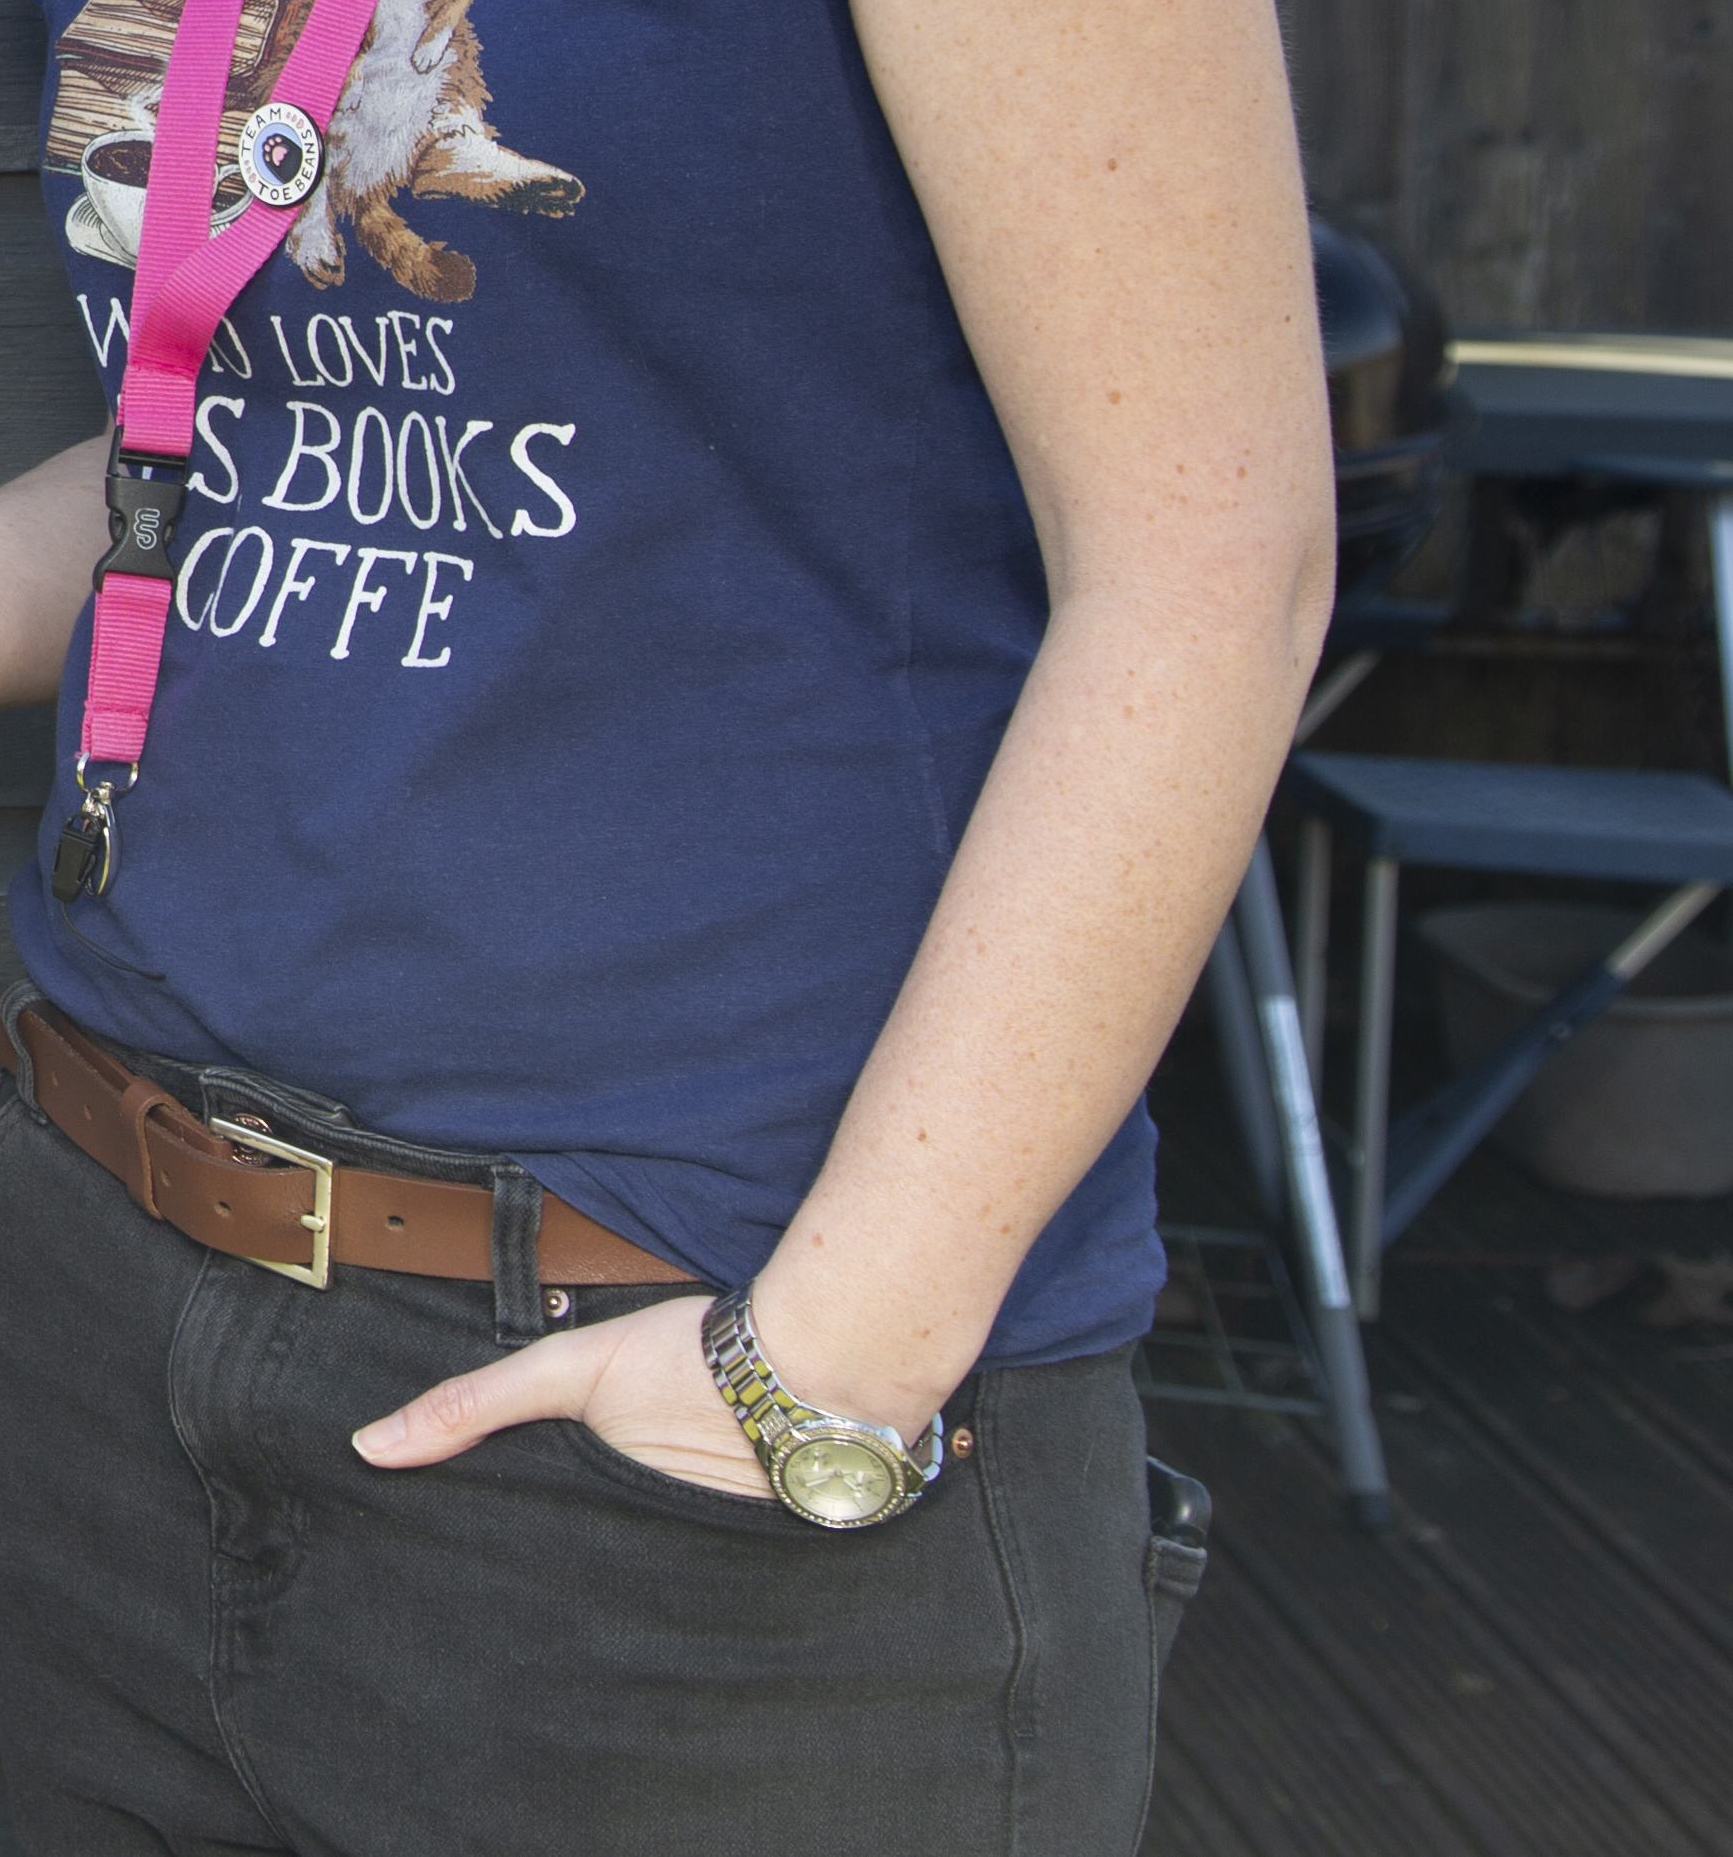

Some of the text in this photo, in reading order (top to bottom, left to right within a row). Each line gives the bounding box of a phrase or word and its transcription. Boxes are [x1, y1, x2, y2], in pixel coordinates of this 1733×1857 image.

[241, 107, 281, 157] TEAM
[258, 129, 316, 201] TOE BEANS
[76, 294, 455, 395] WO LOVES
[261, 400, 576, 539] BOOKS
